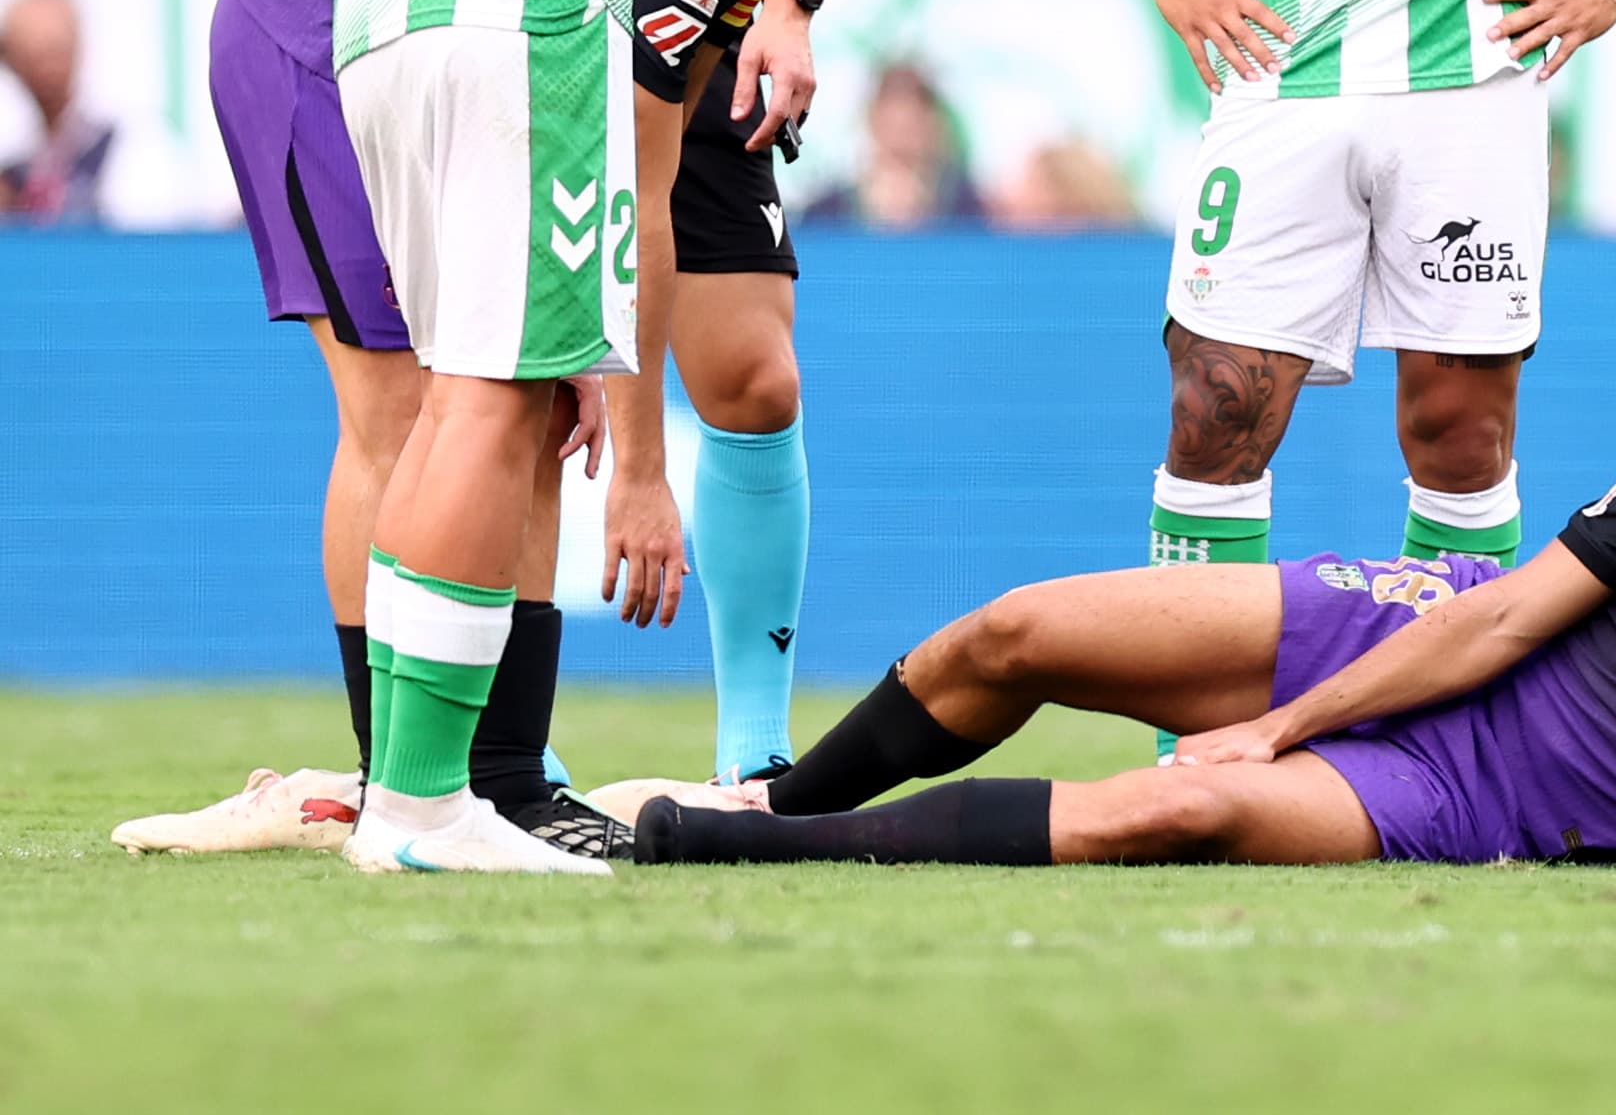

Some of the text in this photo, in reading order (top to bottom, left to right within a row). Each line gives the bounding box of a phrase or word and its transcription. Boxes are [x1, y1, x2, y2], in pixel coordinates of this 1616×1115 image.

[1192, 166, 1241, 256] 9
[1454, 243, 1514, 262] AUS
[1420, 261, 1528, 282] GLOBAL
